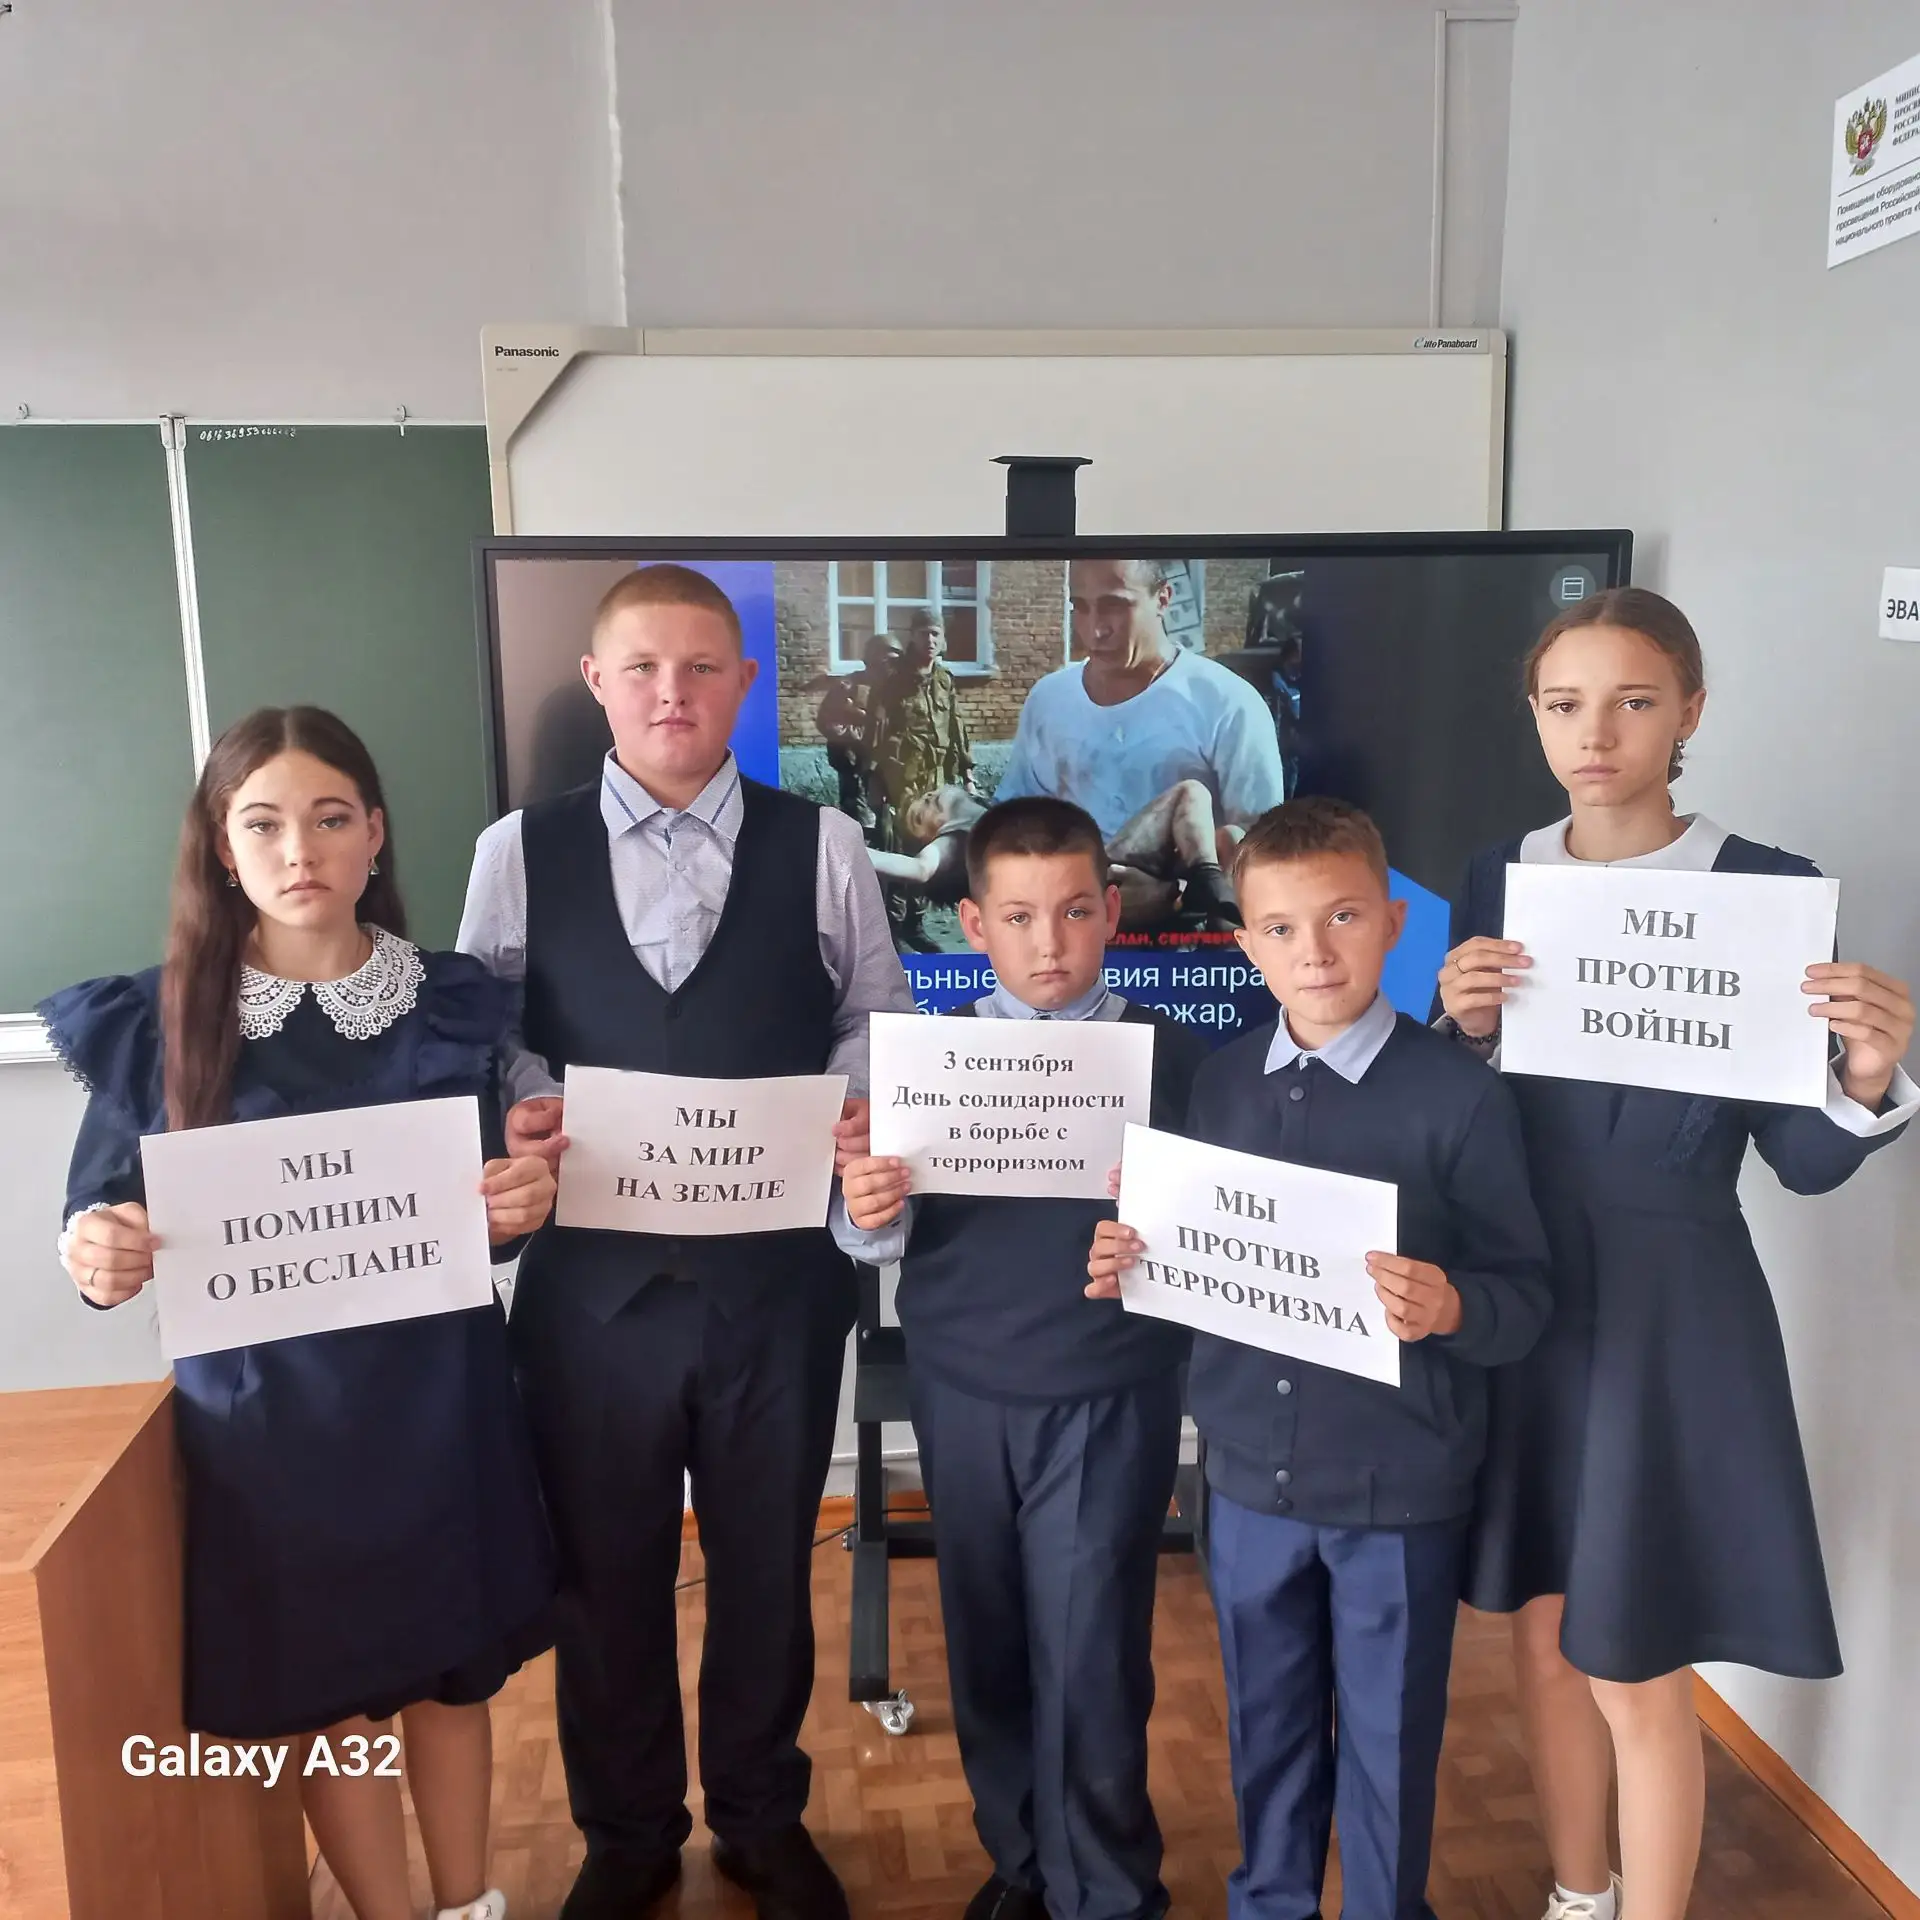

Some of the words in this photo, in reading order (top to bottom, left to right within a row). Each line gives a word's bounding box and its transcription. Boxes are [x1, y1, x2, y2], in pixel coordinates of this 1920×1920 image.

[495, 346, 559, 357] Panasonic
[1437, 339, 1478, 348] Panaboard
[1886, 599, 1919, 621] ЭВА
[1621, 908, 1698, 940] МЫ
[1105, 931, 1153, 946] ЛАН,
[1101, 967, 1159, 988] вия
[1576, 957, 1741, 997] ПРОТИВ
[1140, 1003, 1242, 1030] жар,
[1581, 1007, 1733, 1050] ВОЙНЫ
[943, 1050, 957, 1070] 3
[964, 1053, 1073, 1077] сентября
[892, 1085, 952, 1109] День
[959, 1092, 1125, 1112] солидарности
[675, 1106, 738, 1129] МЫ
[949, 1127, 962, 1140] в
[969, 1122, 1050, 1144] борьбе
[1056, 1127, 1068, 1140] с
[279, 1149, 355, 1184] МЫ
[638, 1141, 678, 1165] ЗА
[690, 1146, 765, 1166] МИР
[928, 1155, 1086, 1174] терроризмом
[615, 1176, 662, 1202] НА
[672, 1179, 786, 1203] ЗЕМЛЕ
[1213, 1185, 1278, 1224] МЫ
[221, 1192, 419, 1246] ПОМНИМ
[1176, 1225, 1321, 1279] ПРОТИВ
[207, 1273, 237, 1301] О
[248, 1239, 443, 1295] БЕСЛАНЕ
[1139, 1258, 1372, 1338] ТЕРРОРИЗМА
